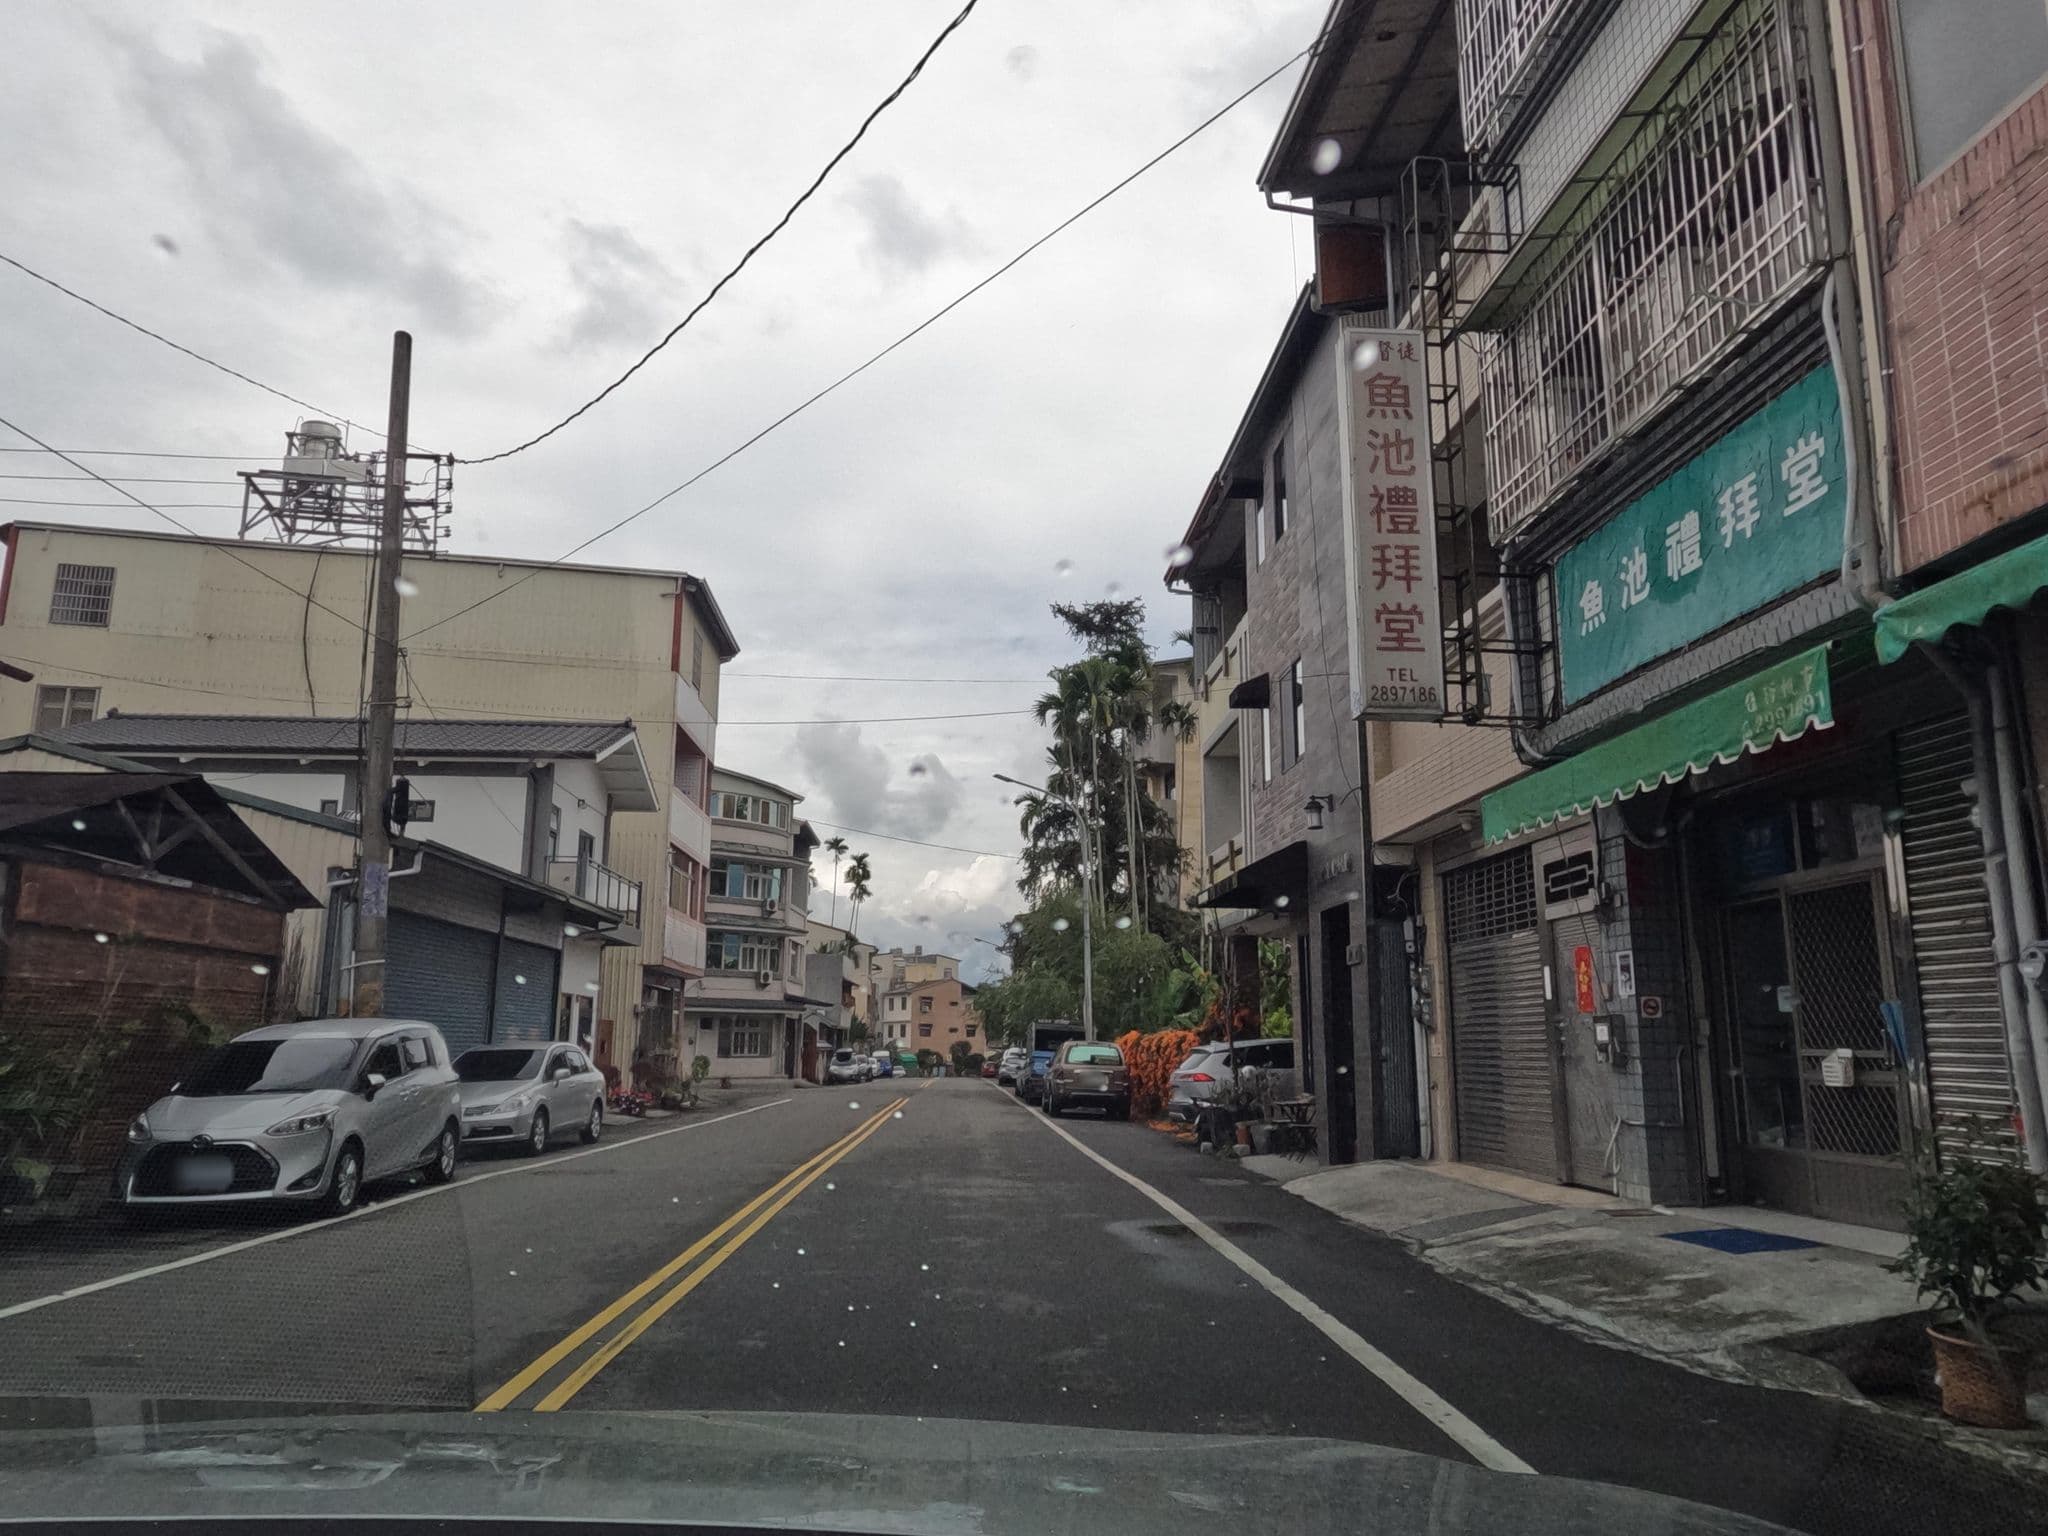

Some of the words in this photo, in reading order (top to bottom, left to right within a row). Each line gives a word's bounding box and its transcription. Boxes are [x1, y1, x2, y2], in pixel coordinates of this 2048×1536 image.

[1363, 371, 1426, 653] 魚池禮拜堂
[1579, 431, 1829, 637] 魚池禮拜堂
[1370, 685, 1438, 704] 2897186
[1386, 667, 1419, 683] TEL
